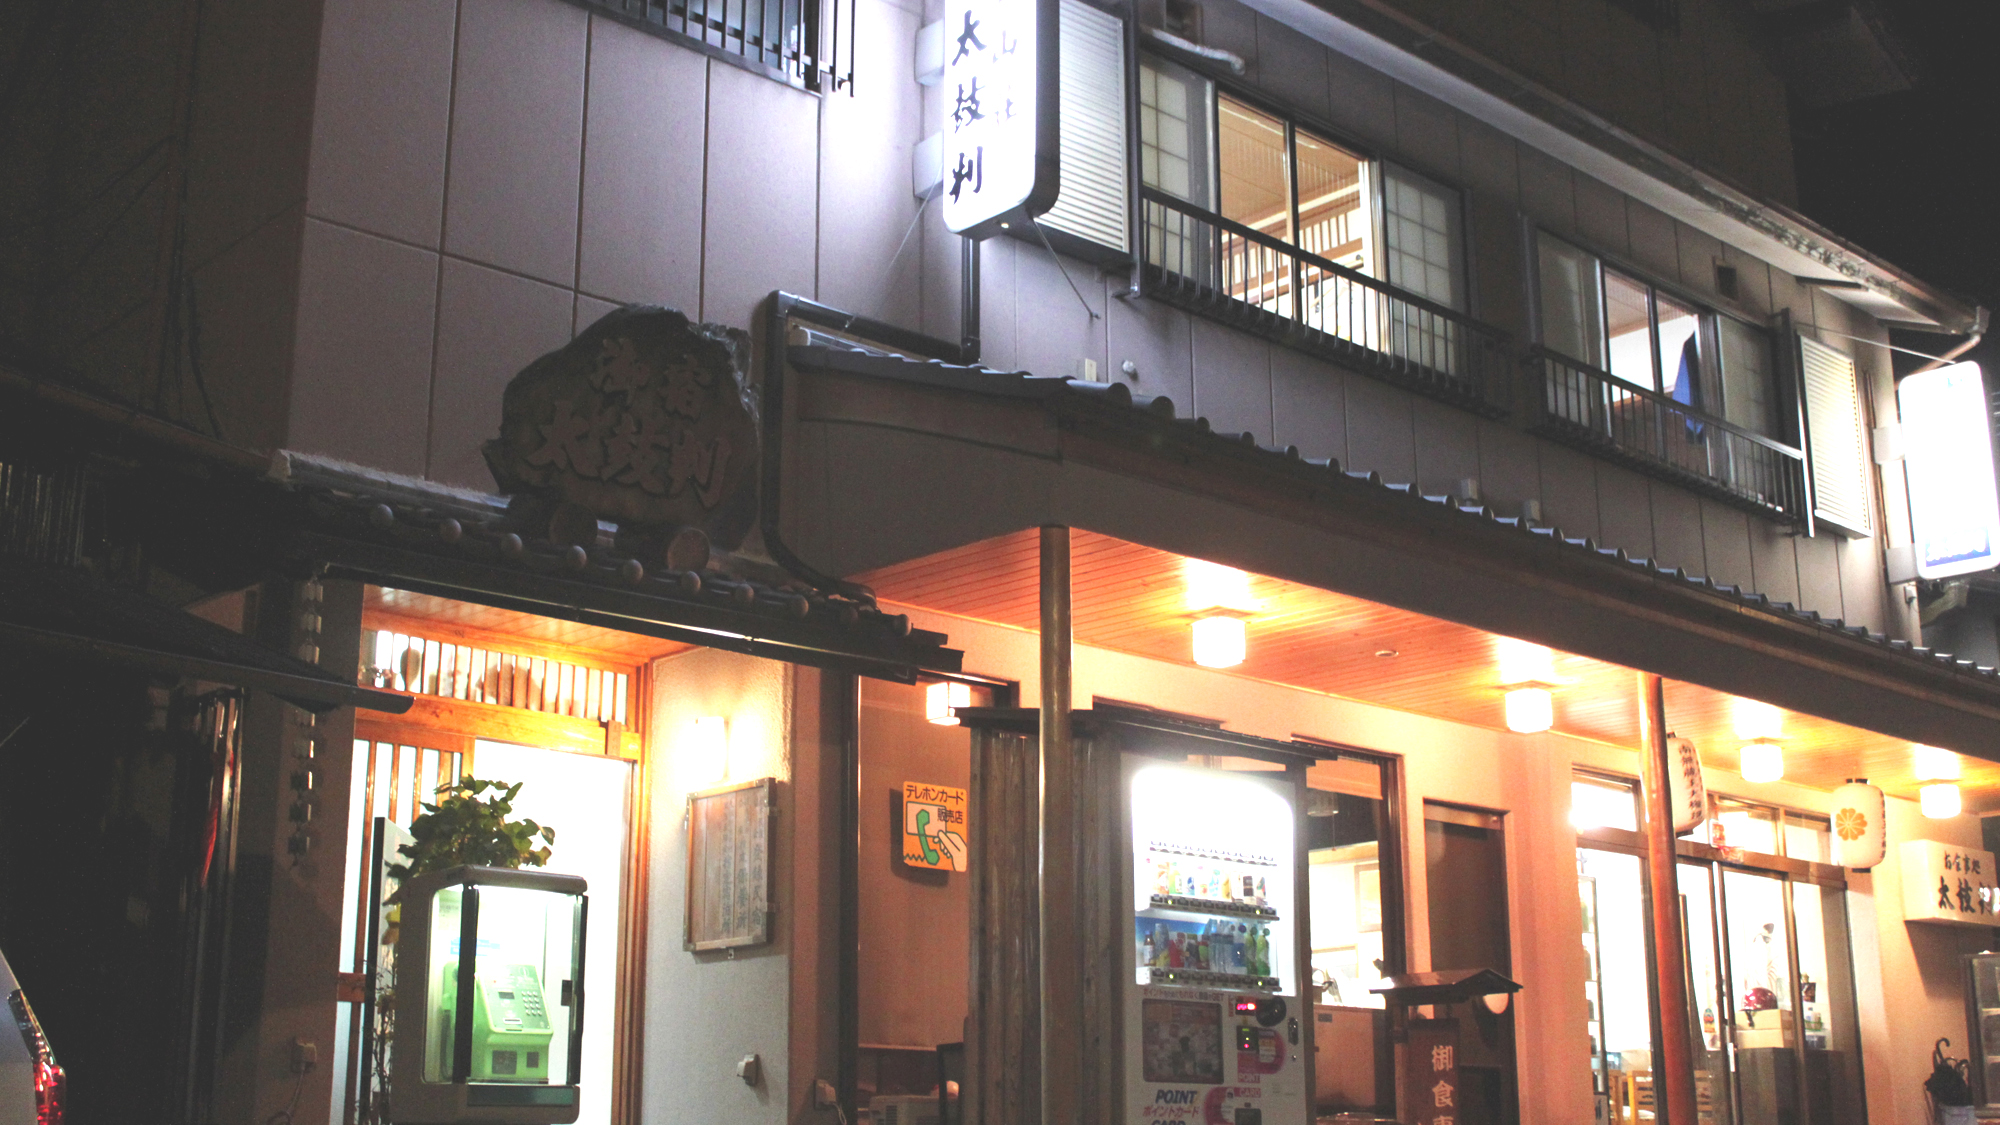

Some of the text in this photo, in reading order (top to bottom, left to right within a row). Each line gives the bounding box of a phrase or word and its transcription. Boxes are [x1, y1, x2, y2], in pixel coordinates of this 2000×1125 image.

[905, 784, 964, 805] テレホンカード
[937, 808, 963, 824] 販売店
[1155, 1089, 1198, 1104] POINT
[1142, 1106, 1199, 1119] ポイントカード
